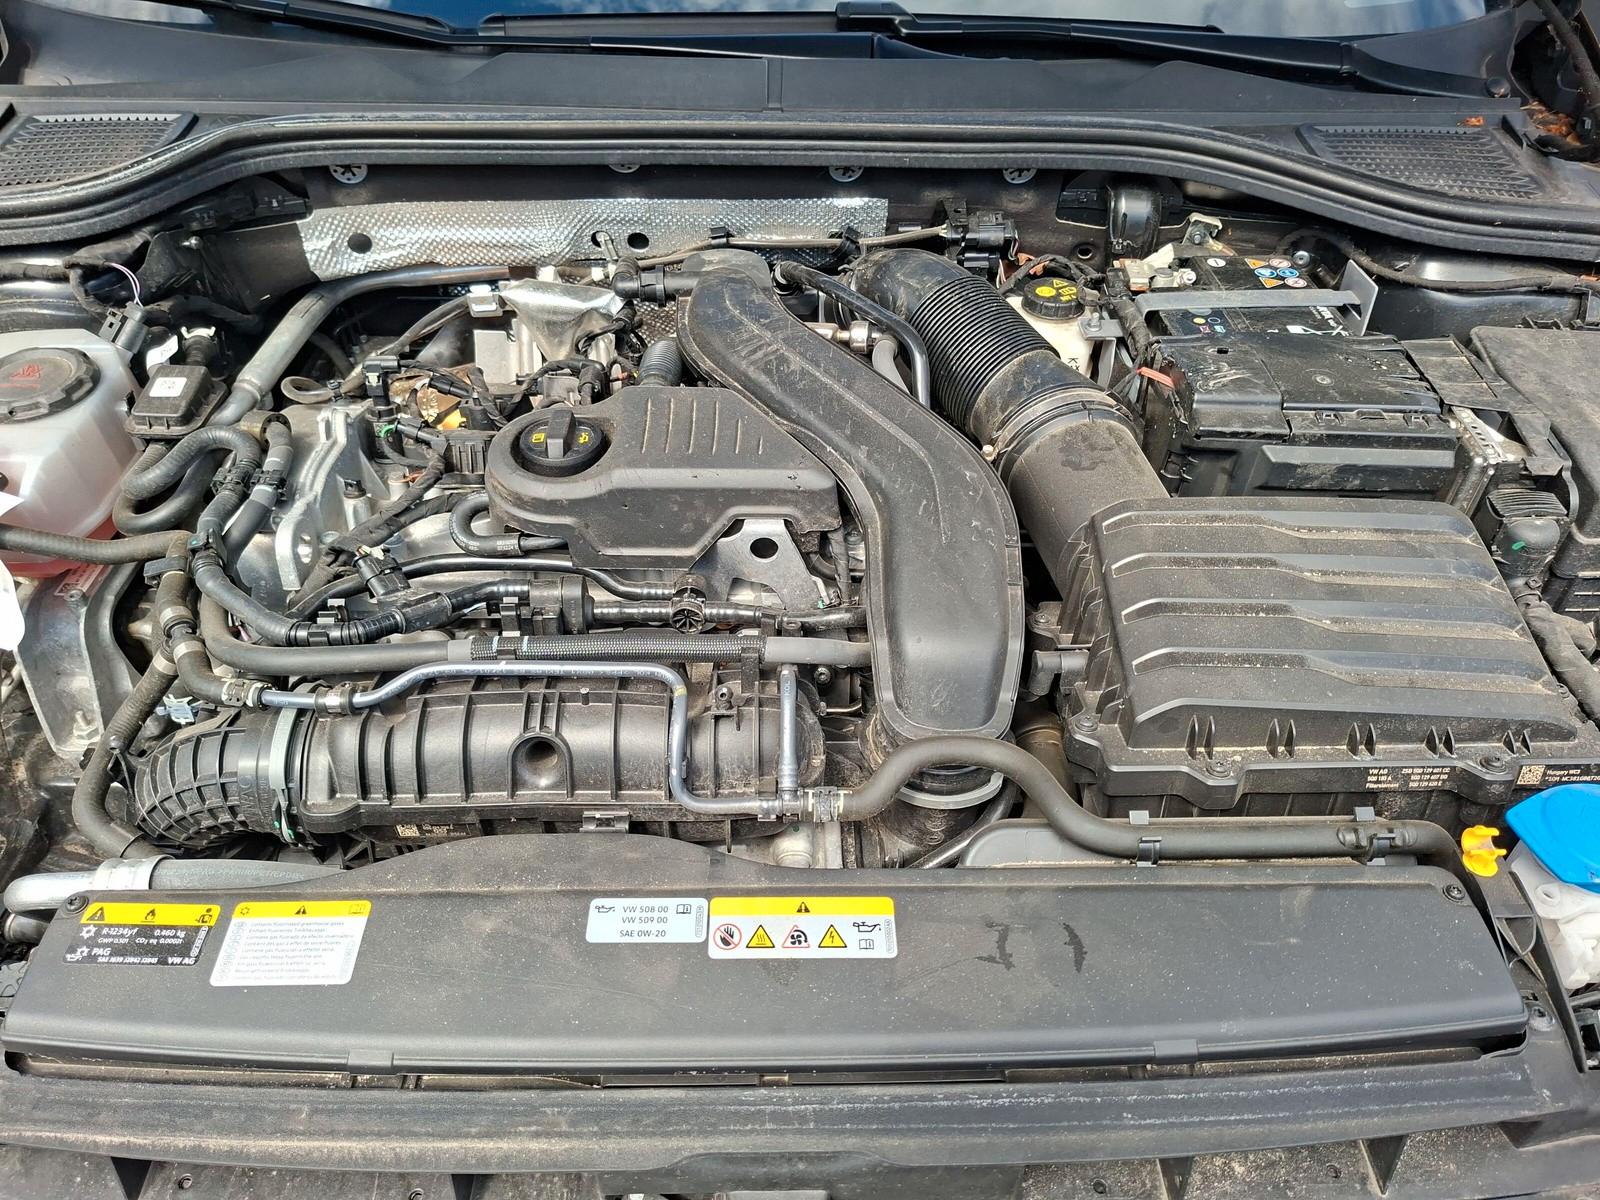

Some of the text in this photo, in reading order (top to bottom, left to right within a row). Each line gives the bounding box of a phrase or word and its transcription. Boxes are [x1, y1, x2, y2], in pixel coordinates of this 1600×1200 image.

[622, 905, 669, 913] VW 508 00
[621, 916, 668, 924] VW 509 00
[101, 927, 139, 937] R-1234yf
[619, 929, 667, 938] SAE 0W-20
[91, 948, 111, 956] PAG
